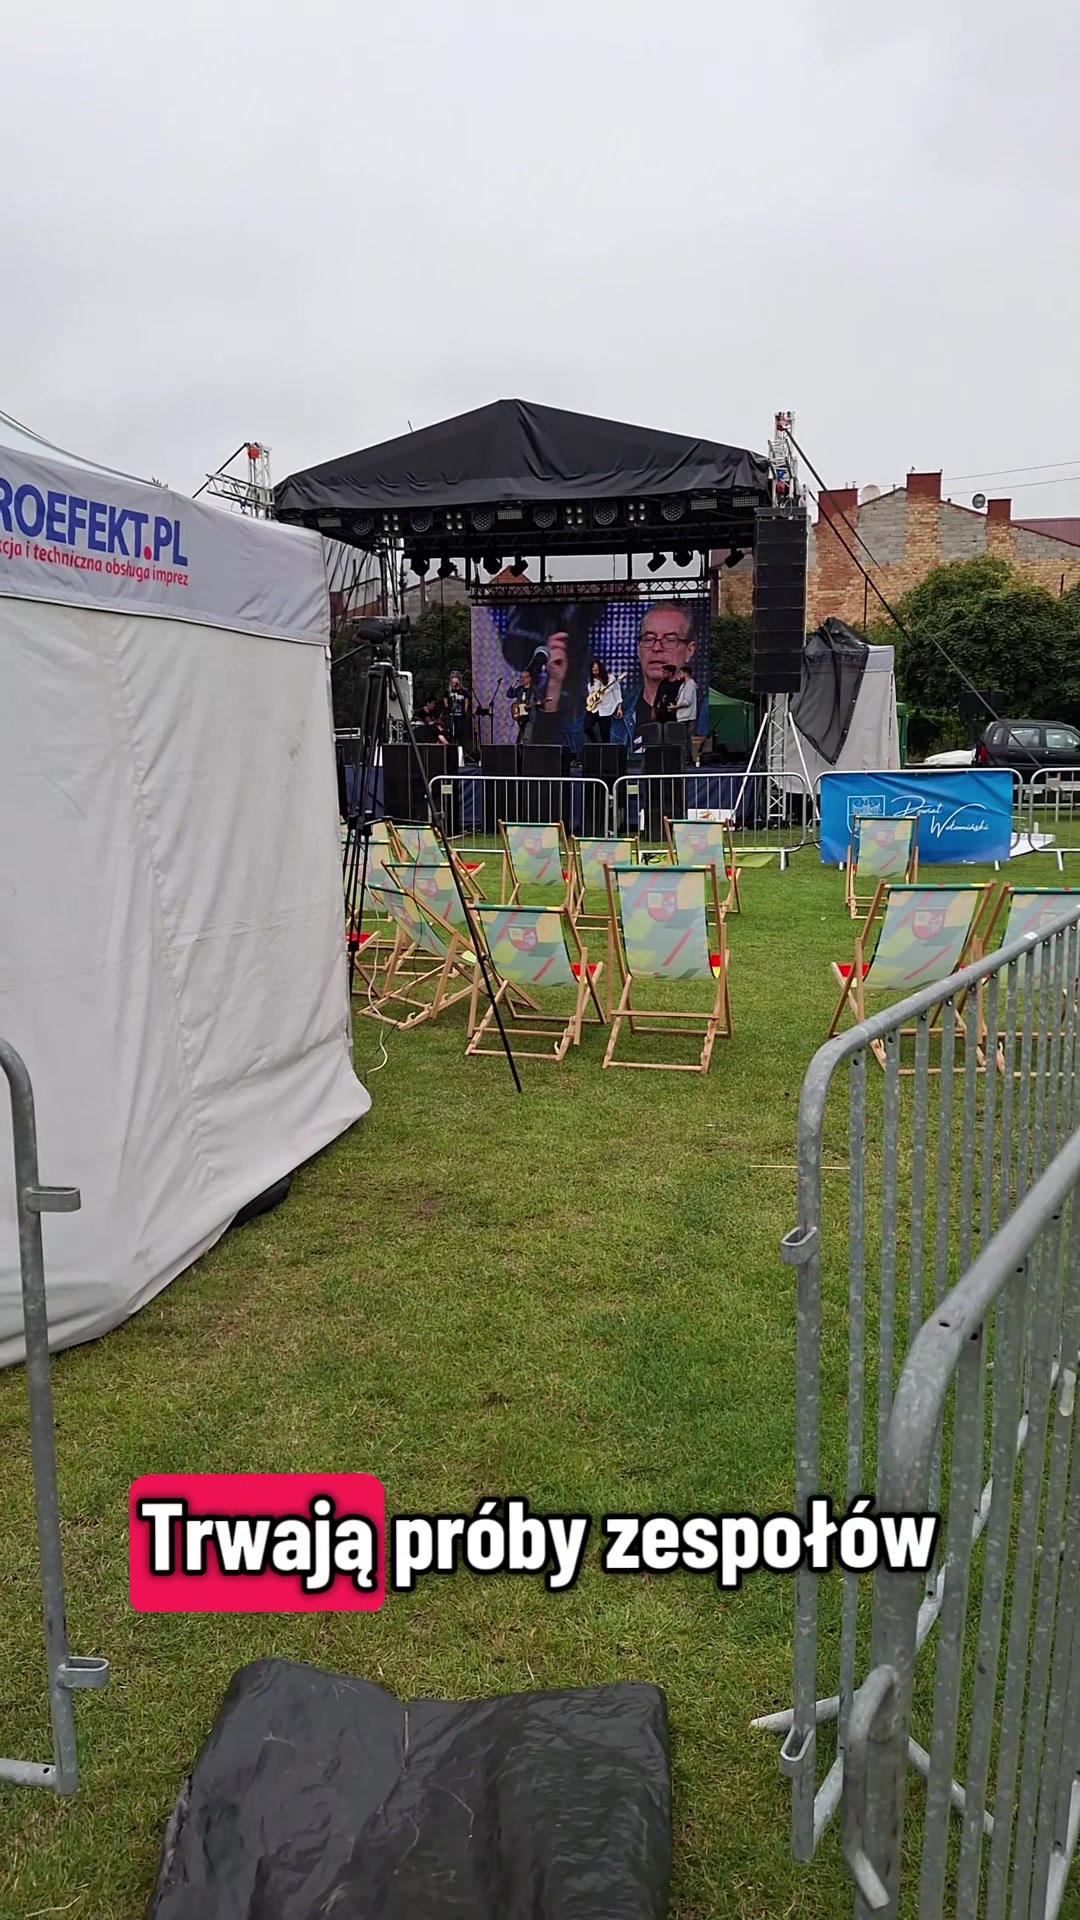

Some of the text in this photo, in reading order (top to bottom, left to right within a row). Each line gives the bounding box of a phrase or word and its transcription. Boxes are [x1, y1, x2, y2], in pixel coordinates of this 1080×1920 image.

[26, 540, 31, 558] i
[34, 543, 102, 573] techniczna
[105, 557, 150, 583] obsługa
[152, 565, 189, 587] imprez
[891, 795, 944, 817] Powiat
